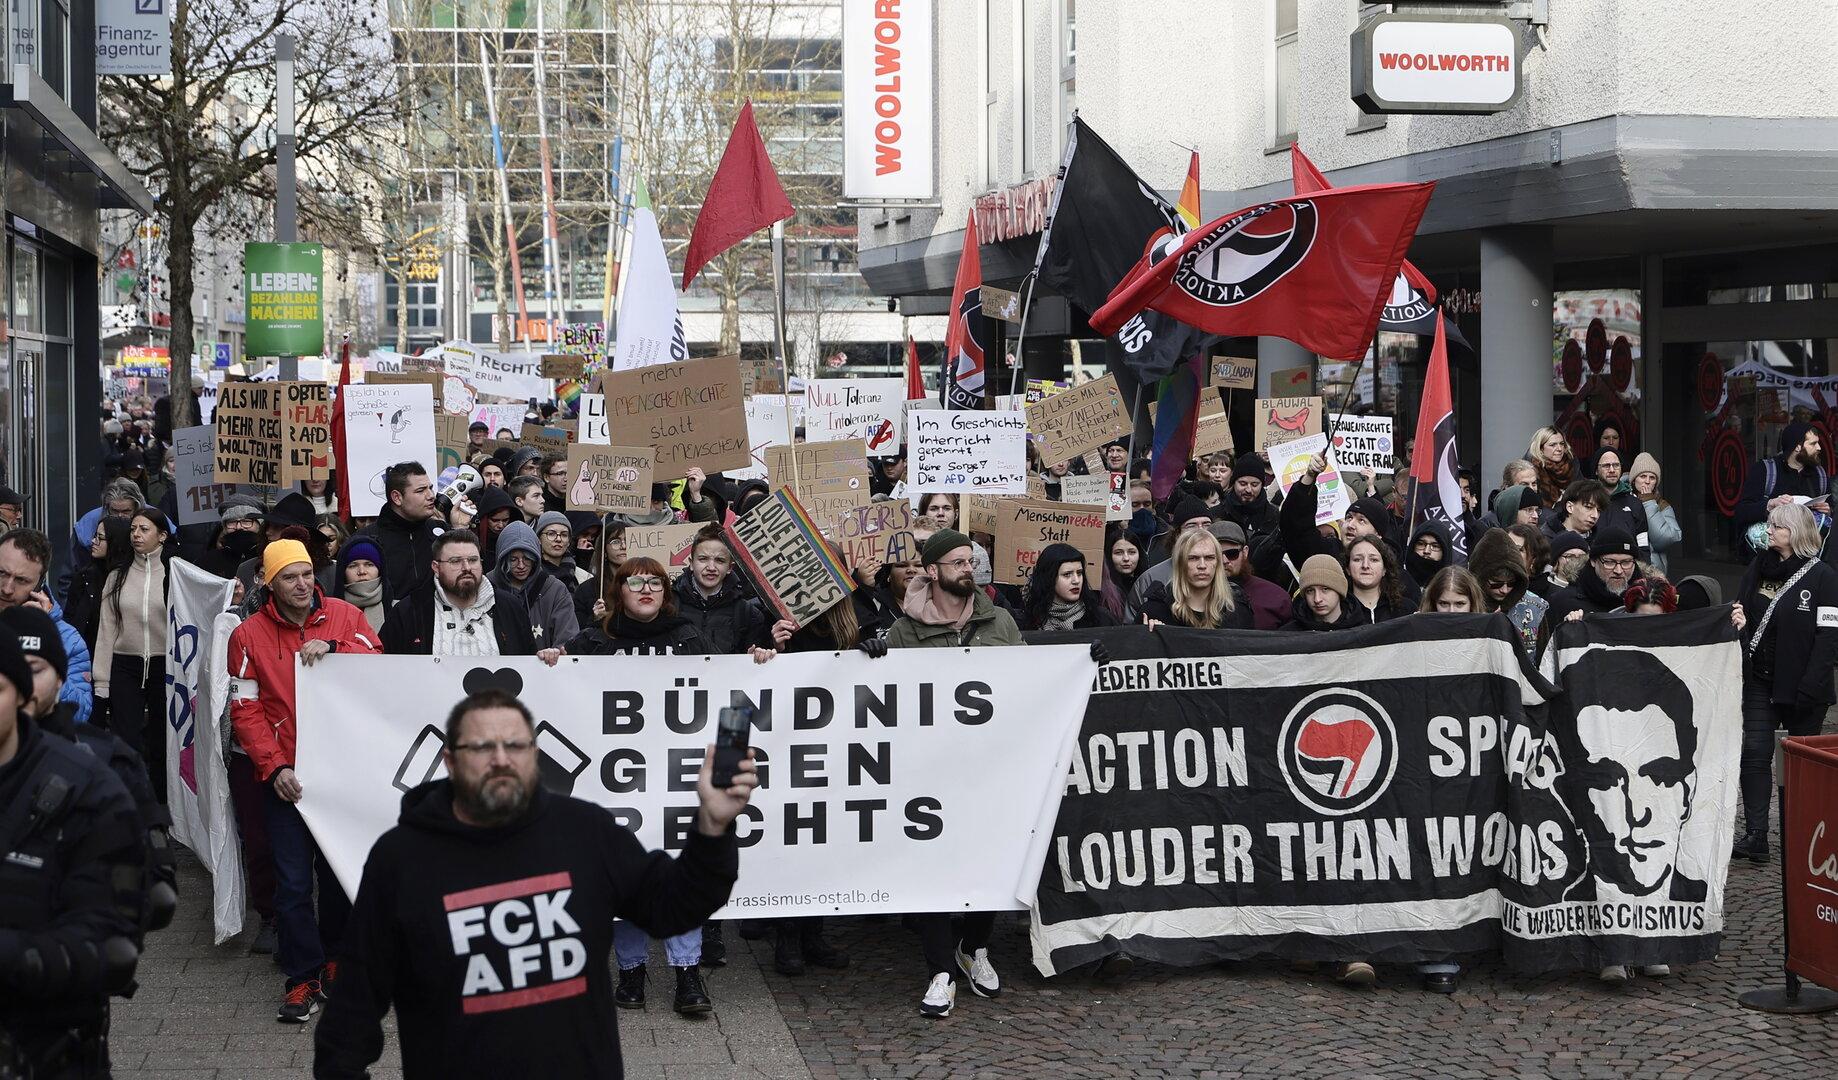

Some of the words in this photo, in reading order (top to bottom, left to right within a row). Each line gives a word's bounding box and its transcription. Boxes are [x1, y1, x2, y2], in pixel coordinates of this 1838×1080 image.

[100, 25, 158, 40] Finanz-
[1379, 53, 1510, 72] WOOLWORTH
[250, 272, 318, 292] LEBEN:
[251, 293, 318, 304] BEZAHLBAR
[252, 306, 318, 320] MACHEN!
[564, 328, 601, 346] BUNT
[480, 354, 541, 377] RECHTS
[641, 364, 684, 384] mehr
[218, 387, 247, 409] ALS
[250, 389, 268, 410] WIR
[842, 386, 882, 408] Toleranz
[951, 388, 978, 408] ION
[1049, 394, 1078, 413] LASS
[1080, 386, 1100, 400] MAL
[1262, 398, 1313, 409] BLAUWAL
[218, 414, 254, 438] MEHR
[762, 412, 774, 420] ist
[824, 411, 882, 431] Intoleranz
[916, 415, 939, 431] Im
[951, 414, 1026, 430] Geschichts-
[1039, 416, 1064, 432] DEN
[300, 426, 328, 445] AfD
[650, 415, 695, 440] statt
[1266, 430, 1296, 441] gegen
[1330, 420, 1391, 434] FRAUENRECHTE
[176, 438, 195, 456] Es
[198, 435, 214, 454] ist
[218, 437, 268, 462] WOLLTEN,
[1050, 426, 1107, 457] STARTEN
[1346, 436, 1377, 450] STATT
[591, 454, 613, 468] NEIN
[918, 446, 972, 462] gepennt?
[1335, 451, 1371, 468] RECHTE
[217, 456, 242, 474] WIR
[600, 482, 612, 491] IST
[612, 484, 632, 492] KEINE
[918, 472, 937, 486] Die
[944, 474, 966, 484] AfD
[972, 473, 1008, 486] auch
[1066, 478, 1089, 489] Techno
[594, 492, 647, 510] ALTERNATIVE
[1014, 506, 1104, 529] Menschenrechte
[628, 530, 666, 550] ALICE
[1039, 526, 1070, 542] Statt
[754, 495, 796, 541] LOVE
[779, 534, 842, 604] FEMBOYS
[838, 534, 885, 569] HATE
[733, 512, 775, 560] HATE
[760, 552, 821, 622] FACISM
[1157, 662, 1222, 690] KRIEG
[602, 677, 995, 735] BÜNDNIS
[1062, 726, 1249, 798] ACTION
[1056, 824, 1255, 893] LOUDER
[1266, 816, 1412, 882] THAN
[446, 888, 582, 956] FCK
[1527, 908, 1585, 936] WIEDER
[1586, 902, 1705, 932] FASCHISMUS
[462, 936, 588, 997] AFD
